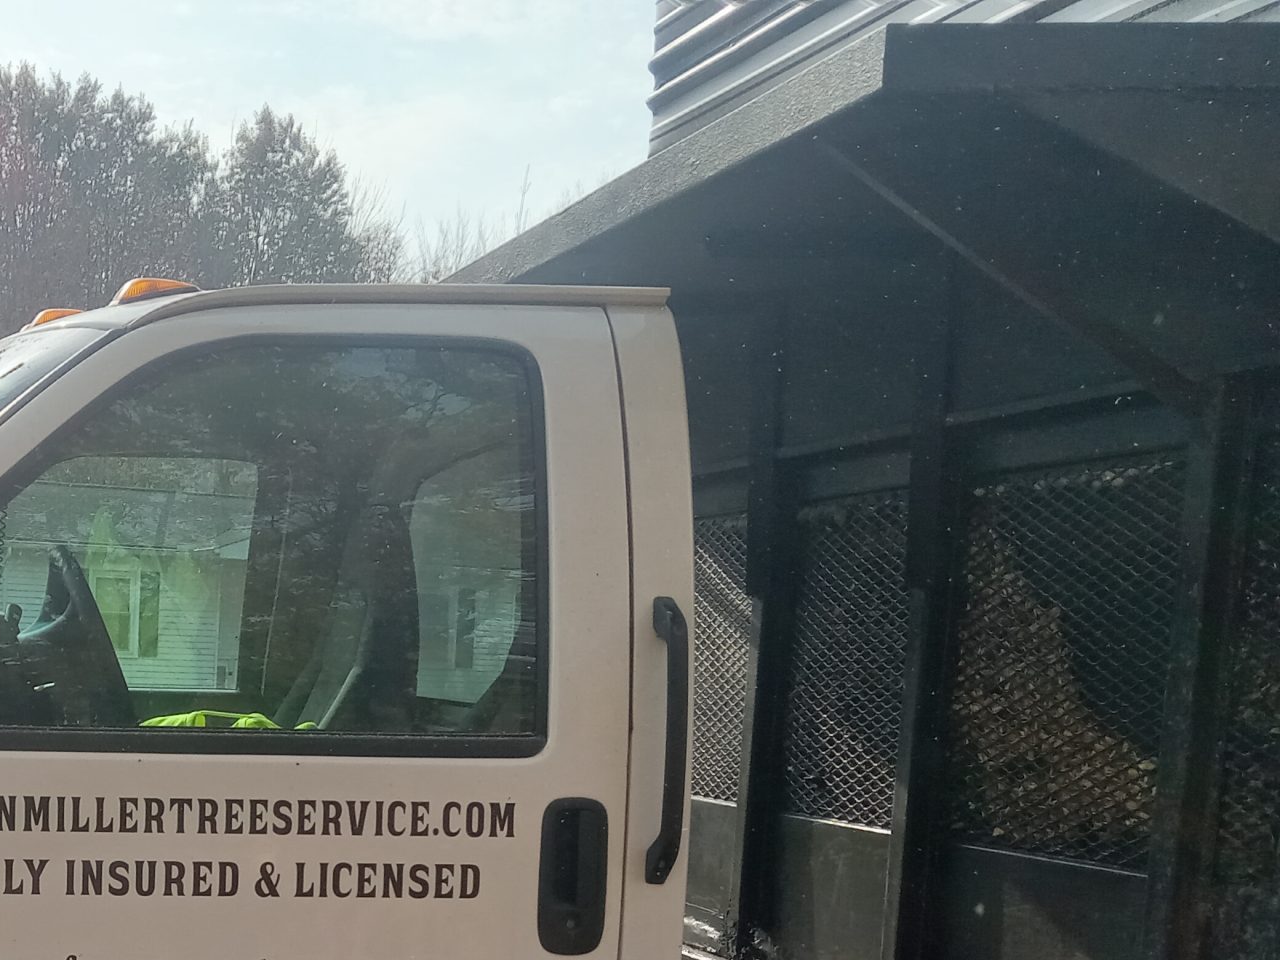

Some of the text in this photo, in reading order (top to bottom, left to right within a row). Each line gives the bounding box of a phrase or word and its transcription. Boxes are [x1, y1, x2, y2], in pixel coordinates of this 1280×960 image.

[65, 859, 239, 897] INSURED
[254, 861, 281, 898] &
[293, 862, 481, 899] LICENSED
